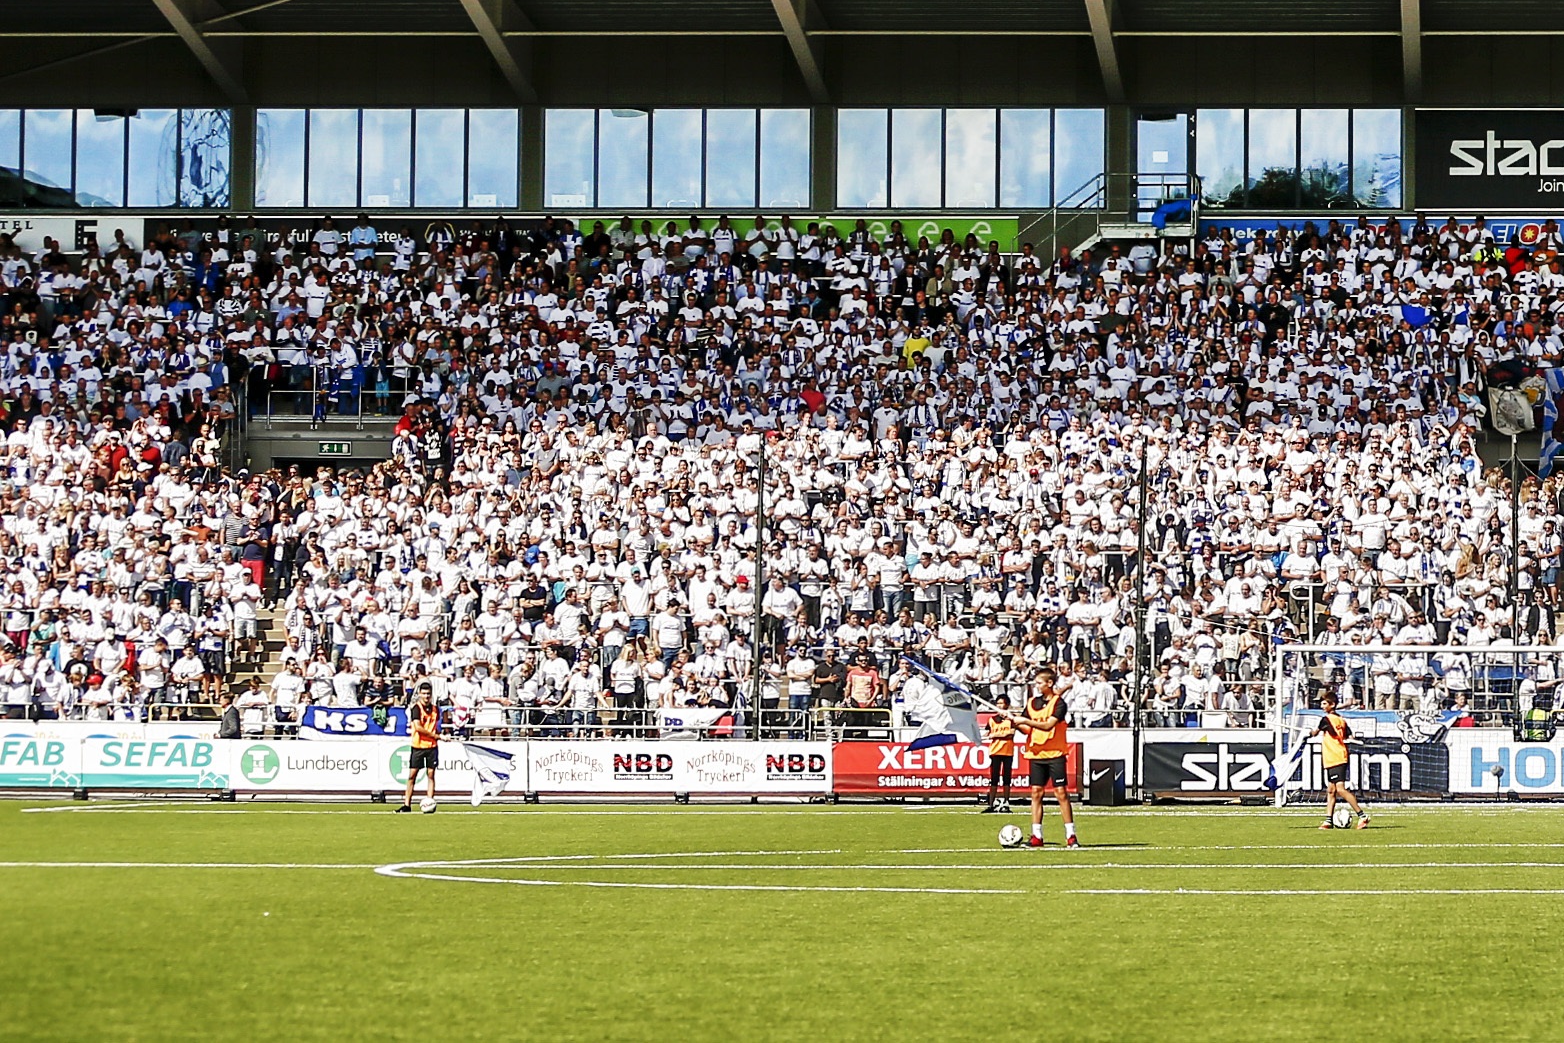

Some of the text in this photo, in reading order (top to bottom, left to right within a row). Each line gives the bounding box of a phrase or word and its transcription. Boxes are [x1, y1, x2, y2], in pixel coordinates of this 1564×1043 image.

[0, 741, 65, 766] FAB
[99, 741, 214, 767] SEFAB
[535, 749, 604, 773] Norrköpings
[613, 753, 673, 773] NBD
[687, 750, 756, 773] Norrköpings
[766, 753, 826, 773] NBD
[878, 744, 1019, 770] XERVO
[287, 756, 368, 774] Lundbergs
[545, 768, 593, 784] Tryckeri
[697, 769, 745, 785] Tryckeri
[878, 775, 942, 788] Ställningar
[946, 776, 956, 787] &
